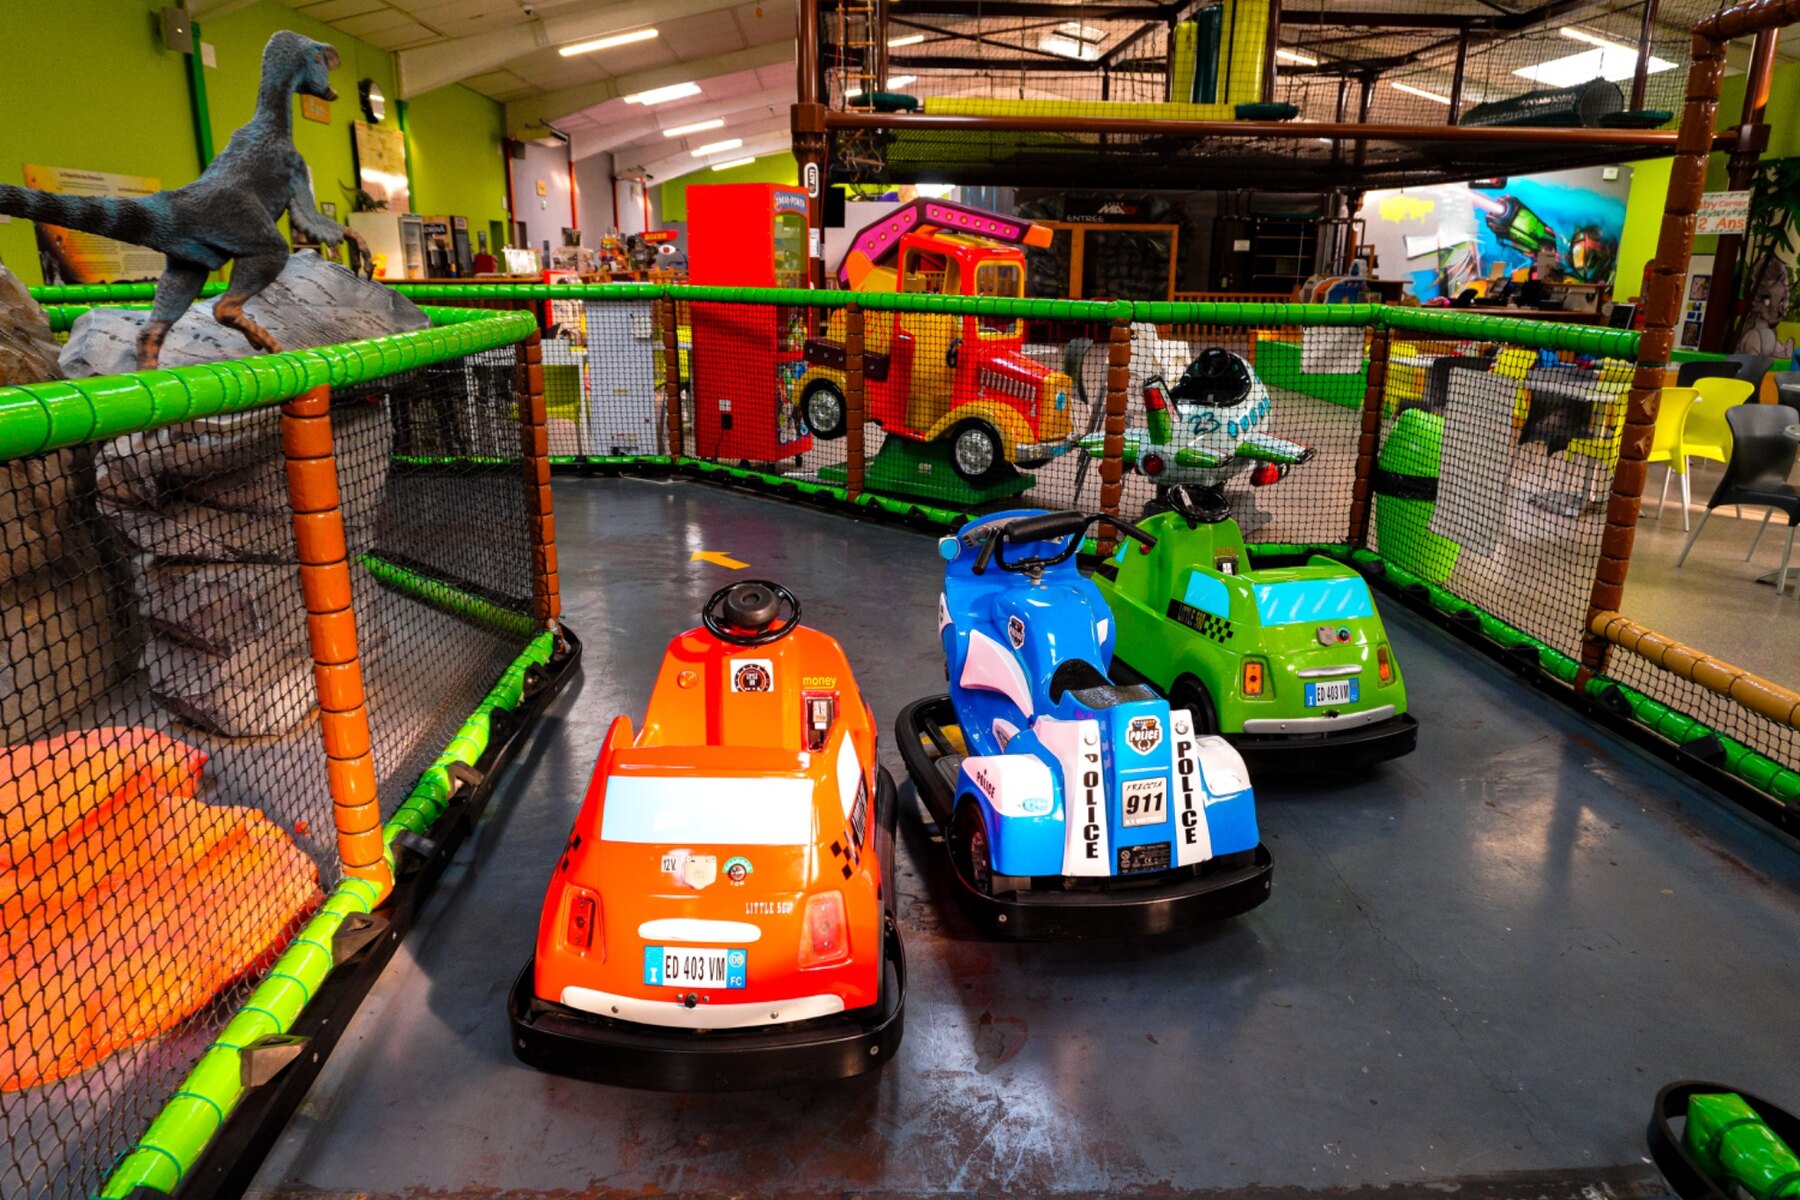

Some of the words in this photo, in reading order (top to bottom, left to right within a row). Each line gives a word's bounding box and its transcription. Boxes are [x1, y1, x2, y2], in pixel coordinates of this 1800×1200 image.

[1715, 217, 1745, 229] Ans
[1188, 411, 1221, 434] 23
[802, 676, 837, 688] money
[1317, 686, 1326, 702] ED
[1327, 685, 1339, 701] 403
[1128, 728, 1160, 742] POLICE
[976, 771, 996, 799] POLICE
[1176, 741, 1198, 845] POLICE
[1083, 752, 1100, 859] POLICE
[1126, 791, 1163, 815] 911
[745, 902, 775, 914] LITTLE
[665, 954, 679, 979] ED
[683, 955, 705, 981] 403
[708, 956, 726, 981] VM
[730, 976, 743, 987] FC
